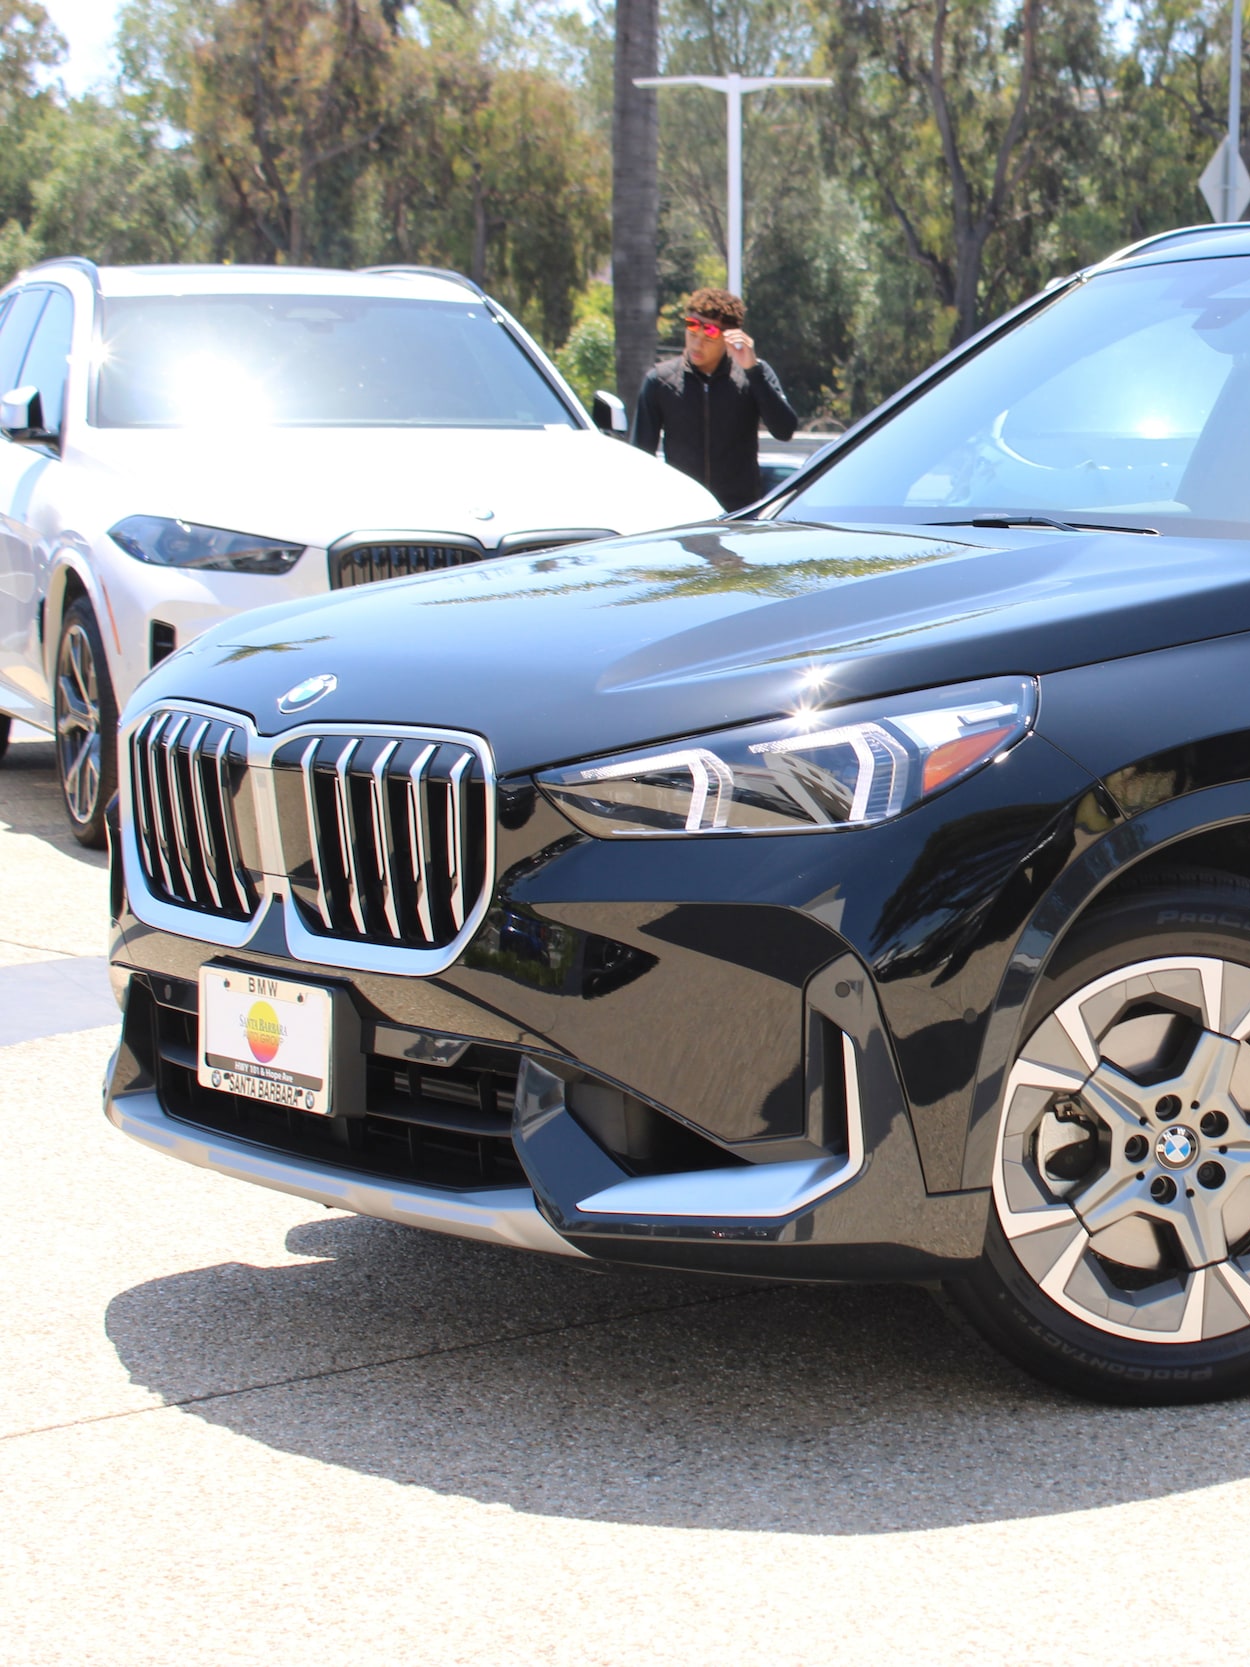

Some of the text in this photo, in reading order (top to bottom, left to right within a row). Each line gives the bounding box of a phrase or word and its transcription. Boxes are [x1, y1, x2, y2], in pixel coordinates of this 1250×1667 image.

[248, 977, 278, 997] BMW
[228, 1074, 298, 1106] SANTA BARBARA
[1156, 1126, 1187, 1153] BMW
